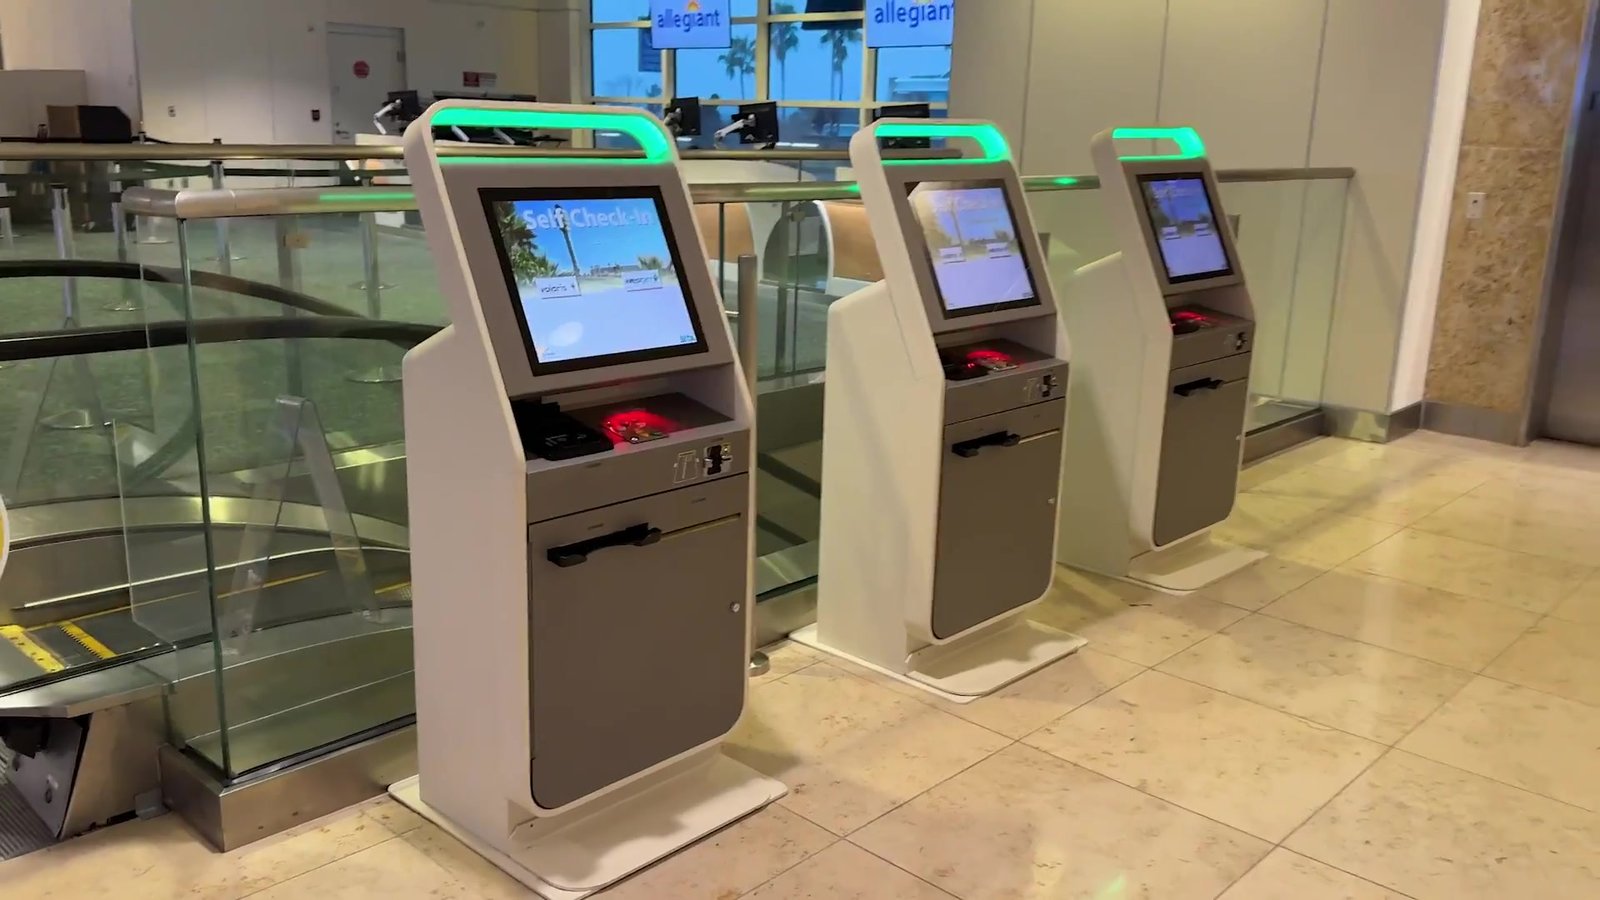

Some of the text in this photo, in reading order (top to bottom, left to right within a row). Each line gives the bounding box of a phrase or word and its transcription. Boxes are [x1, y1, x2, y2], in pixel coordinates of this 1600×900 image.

[658, 9, 720, 32] allegiant
[874, 1, 953, 28] allegian
[522, 206, 654, 230] Self Check-In
